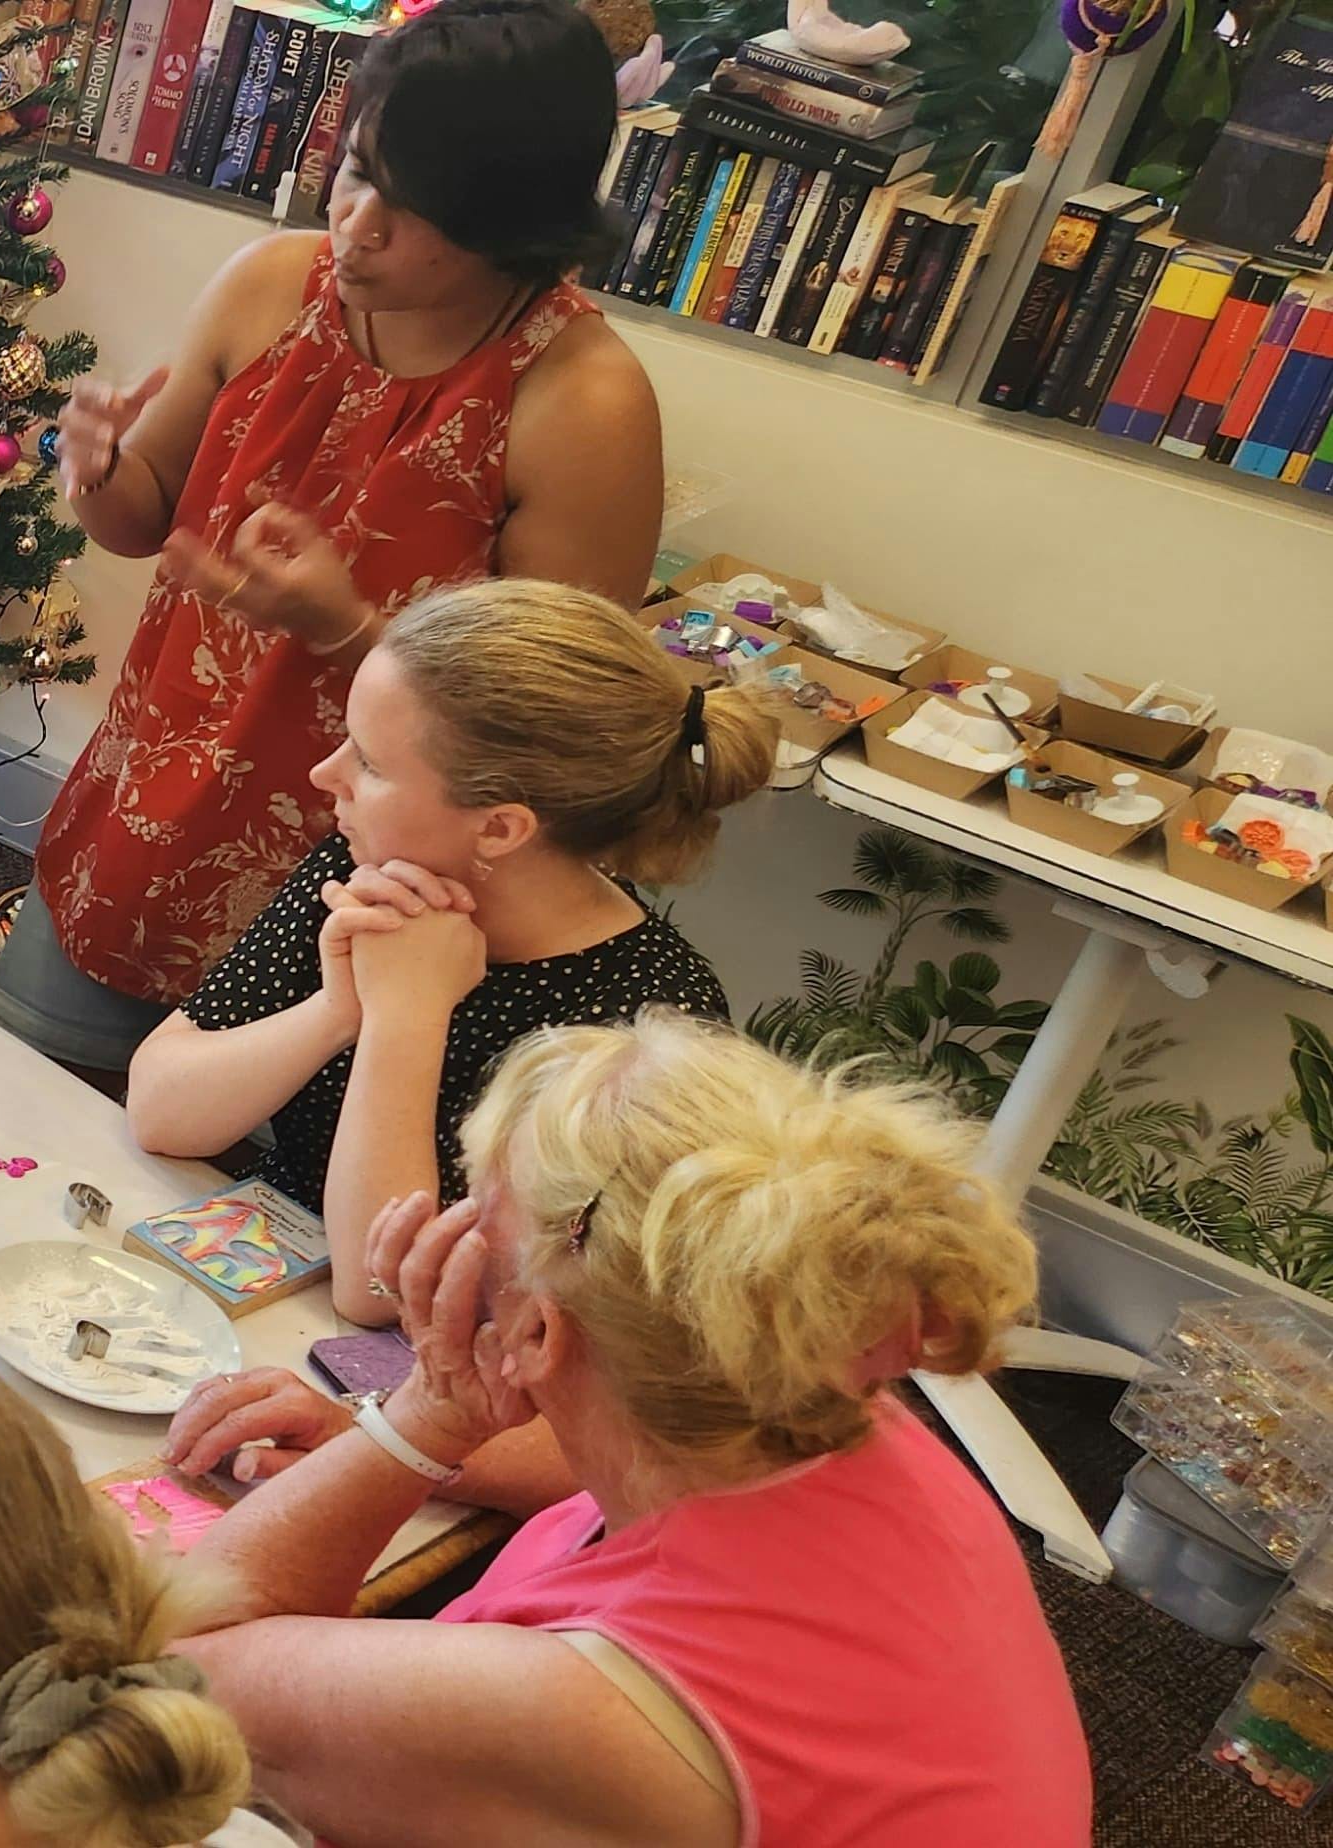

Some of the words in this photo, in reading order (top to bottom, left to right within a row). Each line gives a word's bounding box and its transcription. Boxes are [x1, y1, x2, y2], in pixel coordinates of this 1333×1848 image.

[85, 35, 114, 99] BROWN
[282, 28, 307, 77] COVET
[746, 50, 785, 69] WORLD
[783, 62, 831, 84] HISTORY
[1276, 50, 1310, 67] The
[316, 56, 354, 133] STEPHEN
[807, 101, 841, 126] WARS
[77, 102, 98, 137] DAN
[231, 111, 260, 168] NIGHT
[298, 148, 326, 195] KING
[1013, 277, 1056, 342] NARNIA
